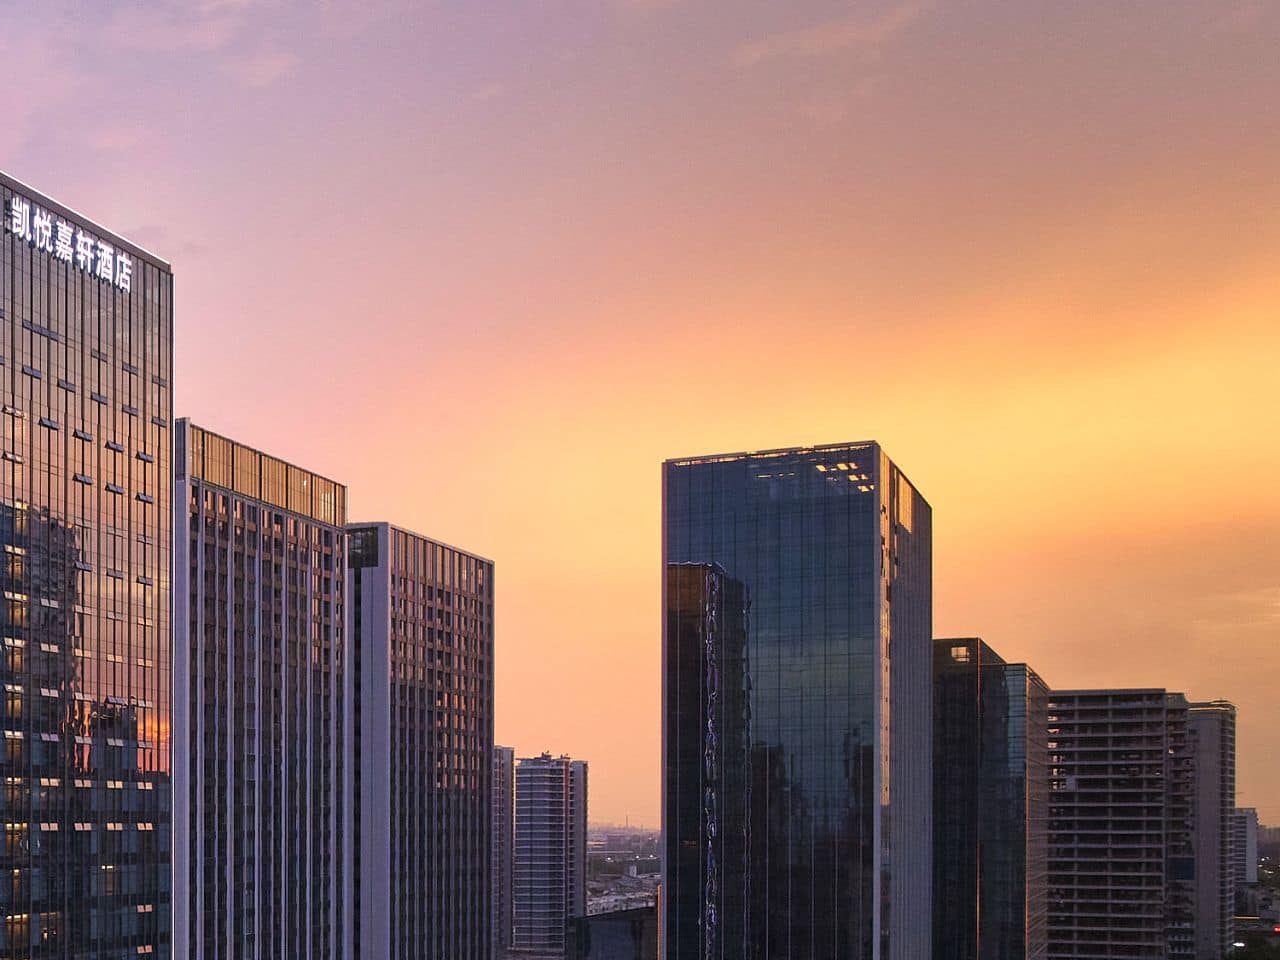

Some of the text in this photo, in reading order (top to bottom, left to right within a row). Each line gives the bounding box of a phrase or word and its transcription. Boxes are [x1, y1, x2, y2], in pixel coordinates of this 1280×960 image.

[11, 197, 132, 293] 凯悦嘉轩酒店
